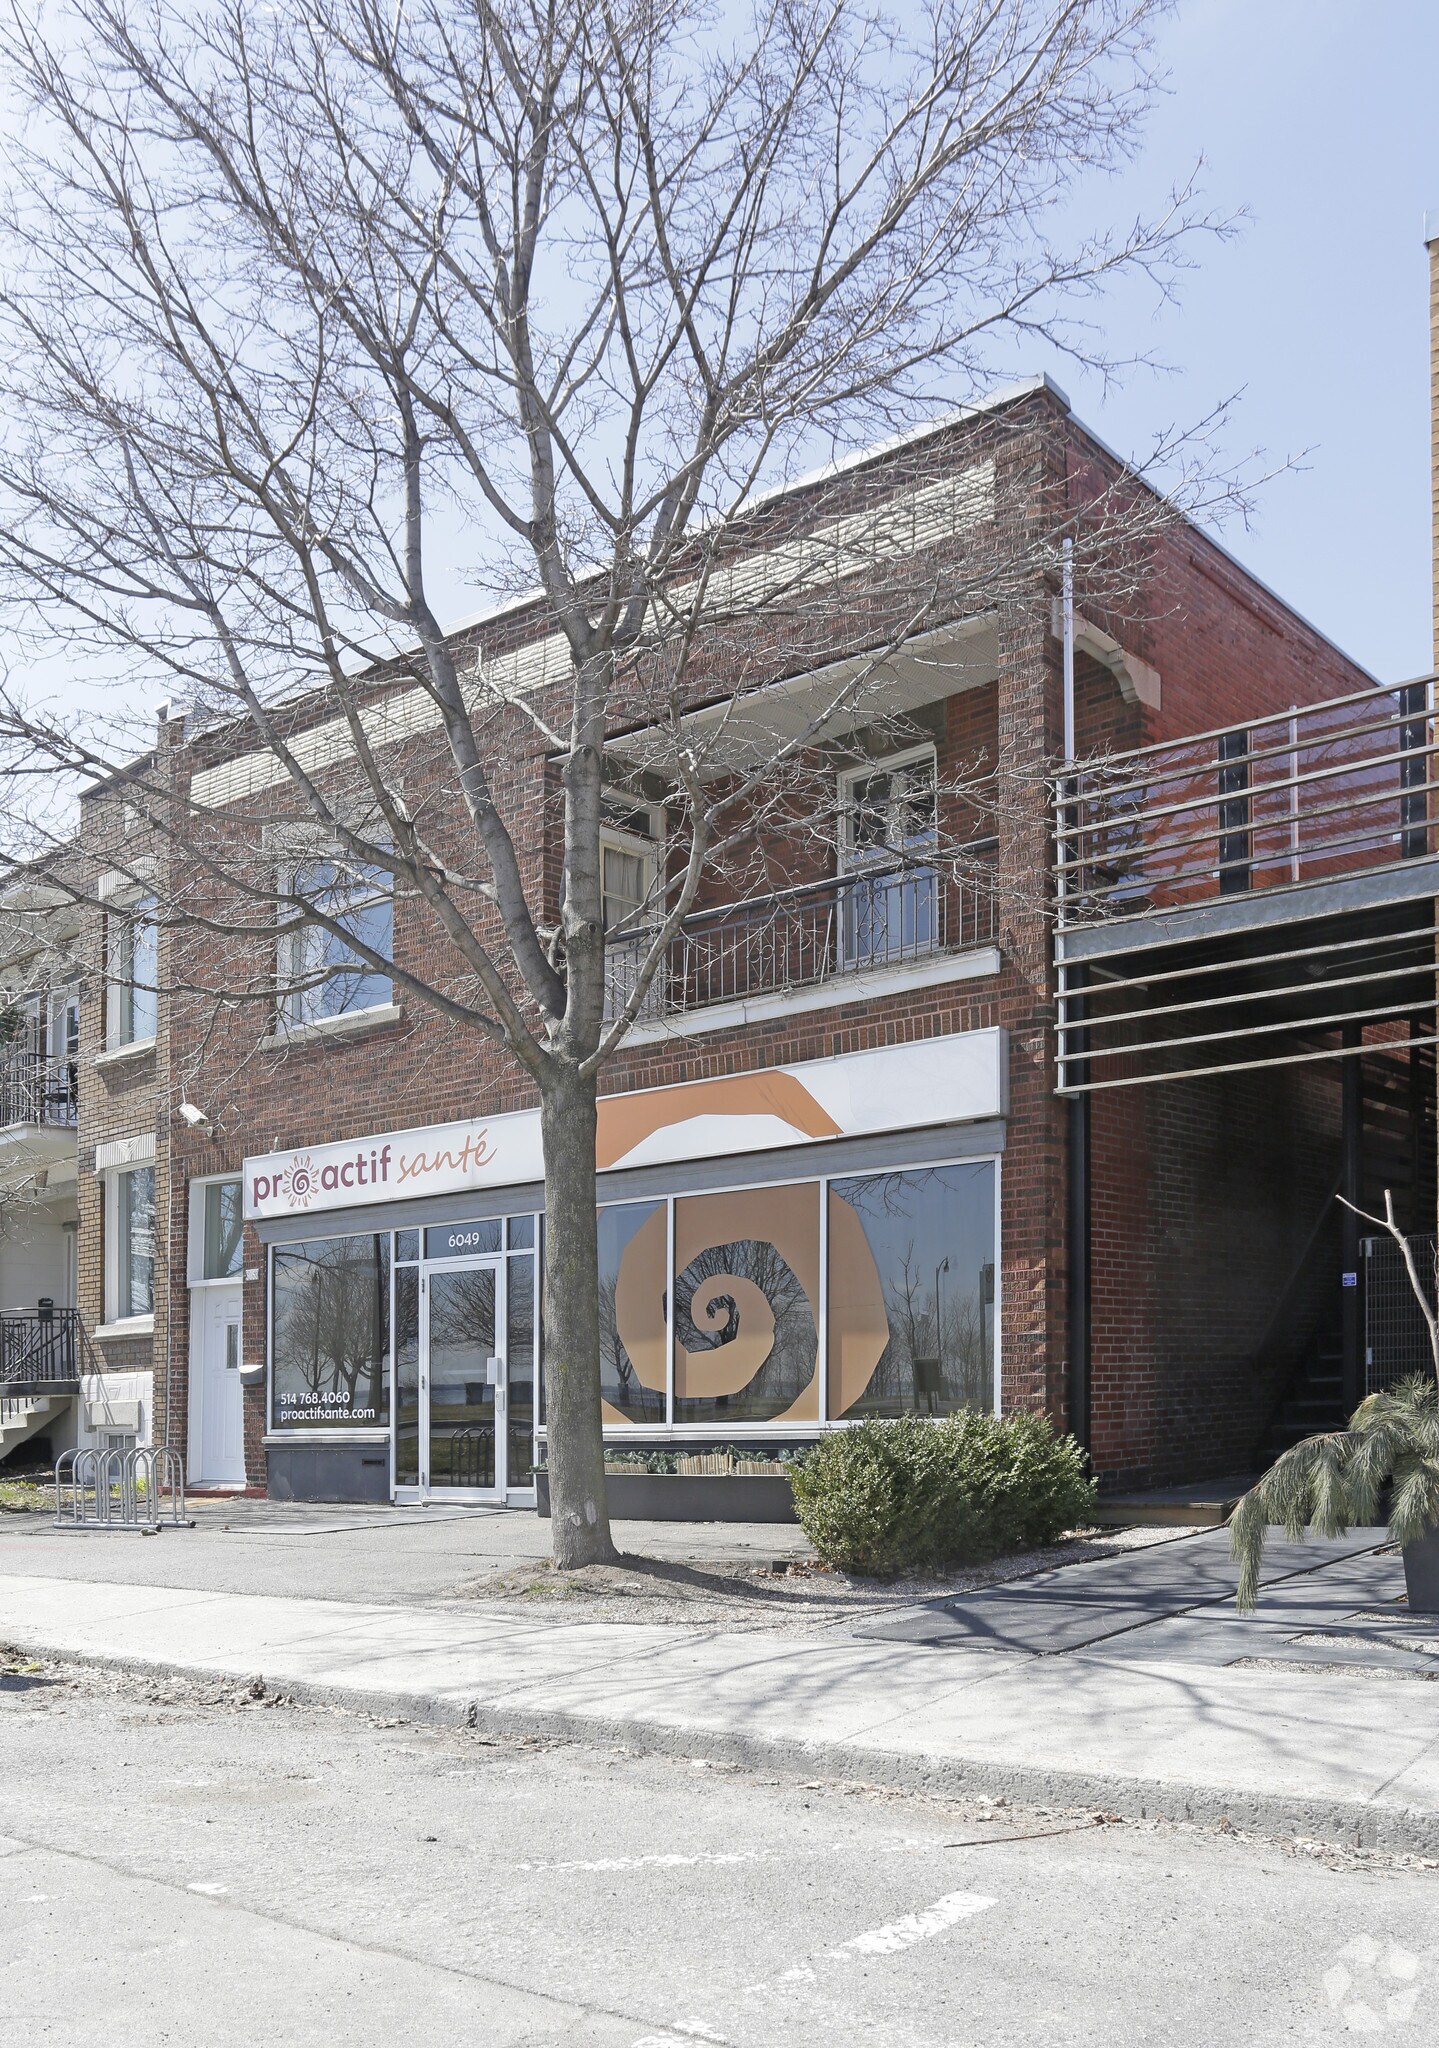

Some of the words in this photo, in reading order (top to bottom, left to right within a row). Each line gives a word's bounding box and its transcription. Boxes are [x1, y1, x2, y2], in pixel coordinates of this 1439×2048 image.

[253, 1144, 392, 1207] proactif
[396, 1128, 498, 1184] santé
[448, 1232, 480, 1248] 6049
[280, 1393, 297, 1405] 514
[299, 1391, 350, 1405] 768.4060
[280, 1406, 375, 1423] proactifsante.com
